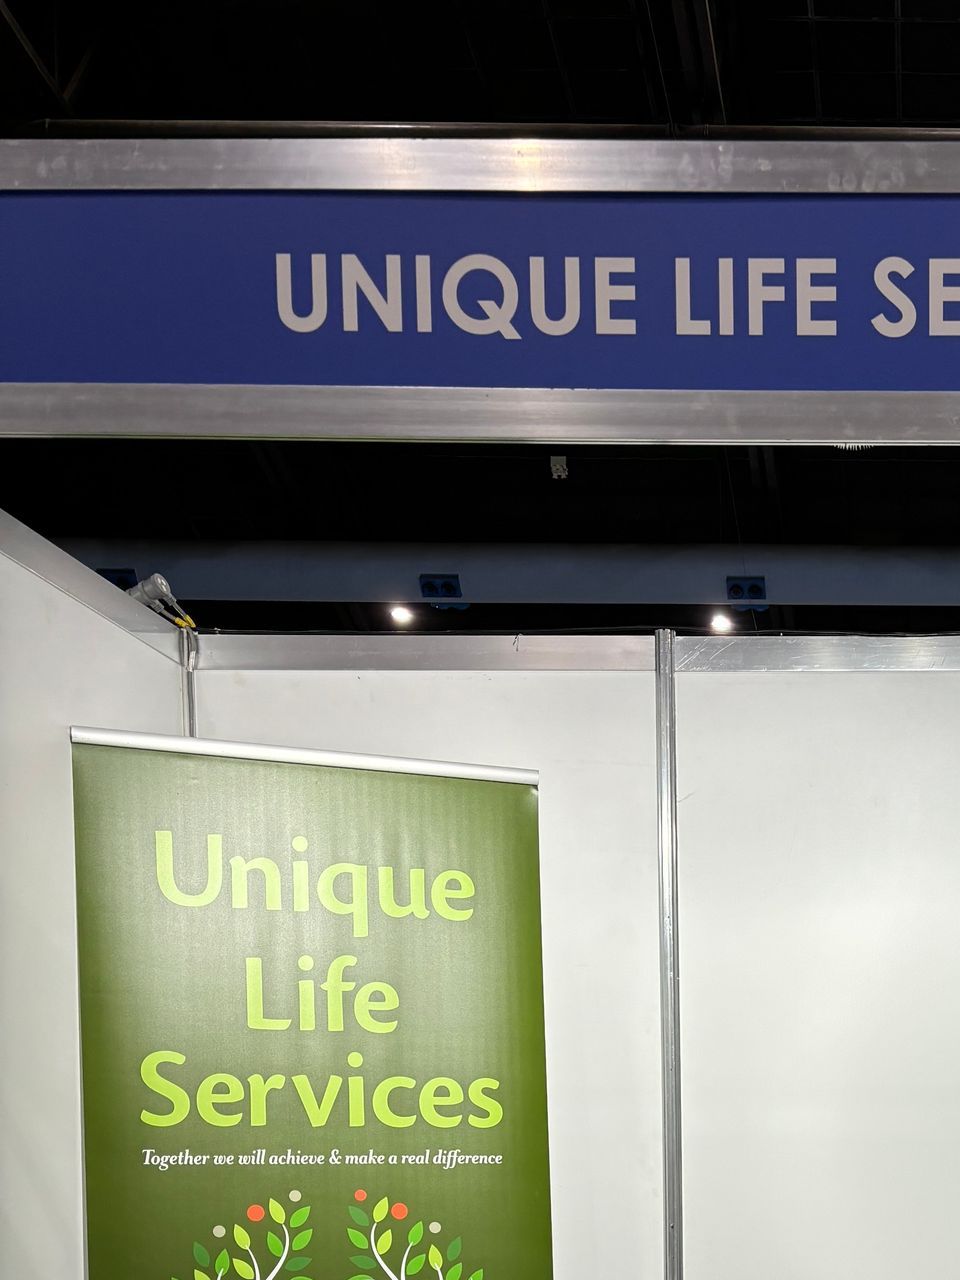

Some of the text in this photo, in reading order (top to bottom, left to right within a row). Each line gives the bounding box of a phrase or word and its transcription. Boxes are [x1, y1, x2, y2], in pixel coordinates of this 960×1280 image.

[274, 251, 638, 340] UNIQUE
[675, 256, 838, 337] LIFE
[155, 830, 476, 938] Unique
[245, 954, 400, 1034] Life
[139, 1050, 504, 1129] Services
[142, 1148, 503, 1171] Together we will achieve & make a real difference
